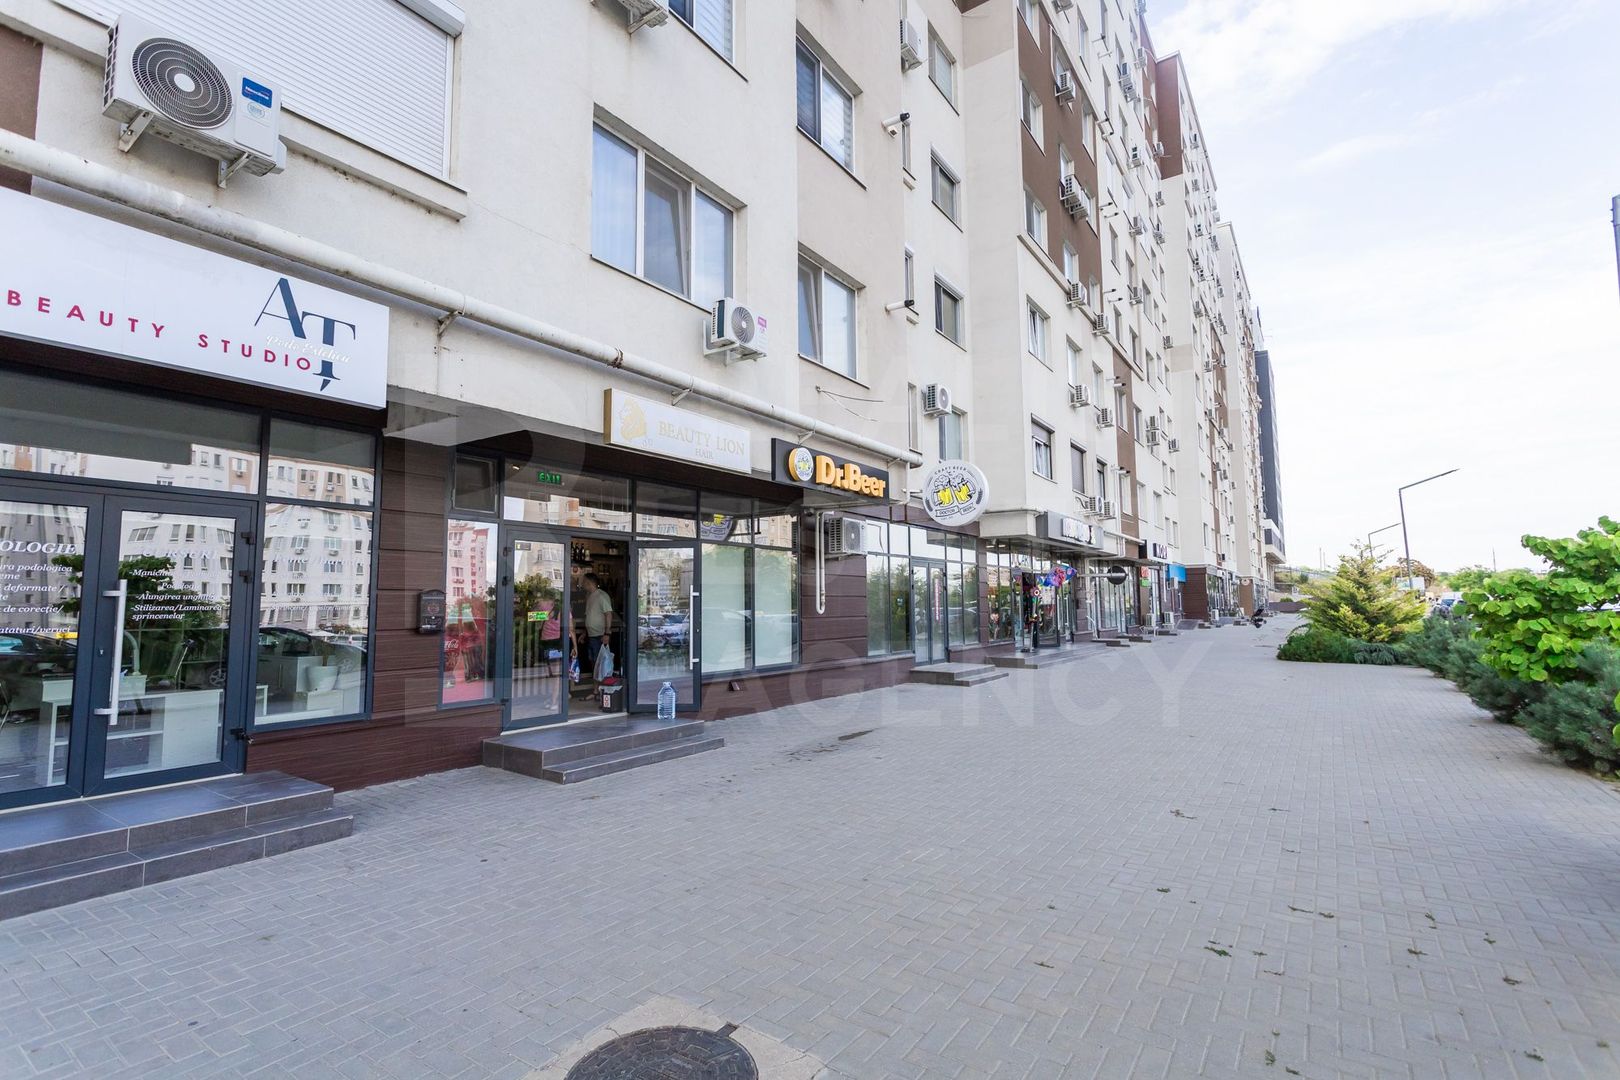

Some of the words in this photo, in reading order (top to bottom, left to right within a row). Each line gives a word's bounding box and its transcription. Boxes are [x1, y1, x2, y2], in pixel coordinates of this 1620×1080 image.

[6, 289, 165, 339] BEAUTY
[198, 333, 311, 371] STUDIO
[658, 421, 711, 447] BEAUTY
[717, 436, 745, 455] LION
[695, 449, 714, 460] HAIR
[538, 472, 561, 483] EXIT
[815, 455, 886, 498] Dr.Beer
